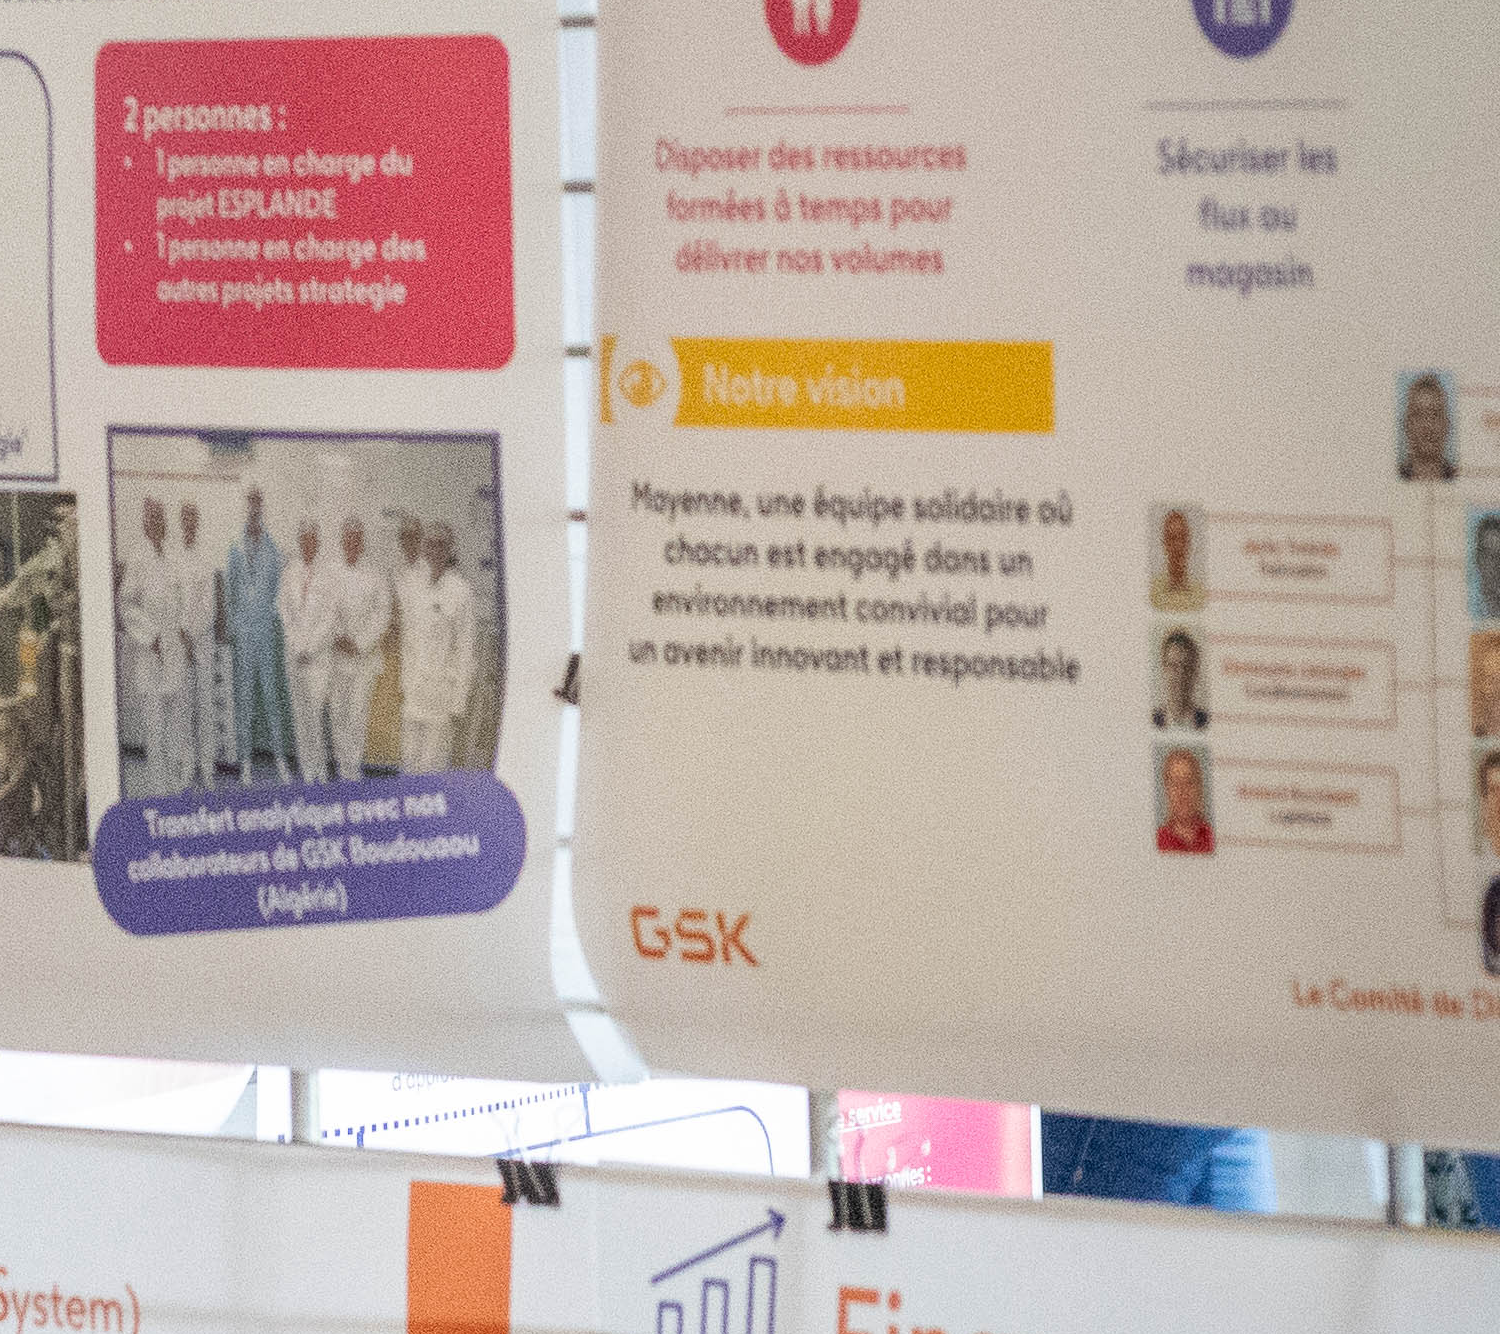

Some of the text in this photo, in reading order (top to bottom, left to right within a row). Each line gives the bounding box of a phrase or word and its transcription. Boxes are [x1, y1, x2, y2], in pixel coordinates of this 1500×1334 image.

[123, 95, 139, 134] 2
[142, 103, 273, 137] personnes
[156, 146, 414, 183] 1 personne en charge du
[156, 230, 427, 268] 1 personne en charge des
[703, 365, 906, 410] Notre vision
[756, 492, 807, 519] une
[812, 486, 906, 528] équipe
[912, 489, 1031, 526] solidaire
[1037, 491, 1074, 527] où
[663, 534, 1033, 581] chacun est engagé dans un
[651, 589, 1048, 635] environnement convivial pour
[628, 640, 1081, 686] un avenir innovant et responsable
[629, 905, 759, 968] GSK
